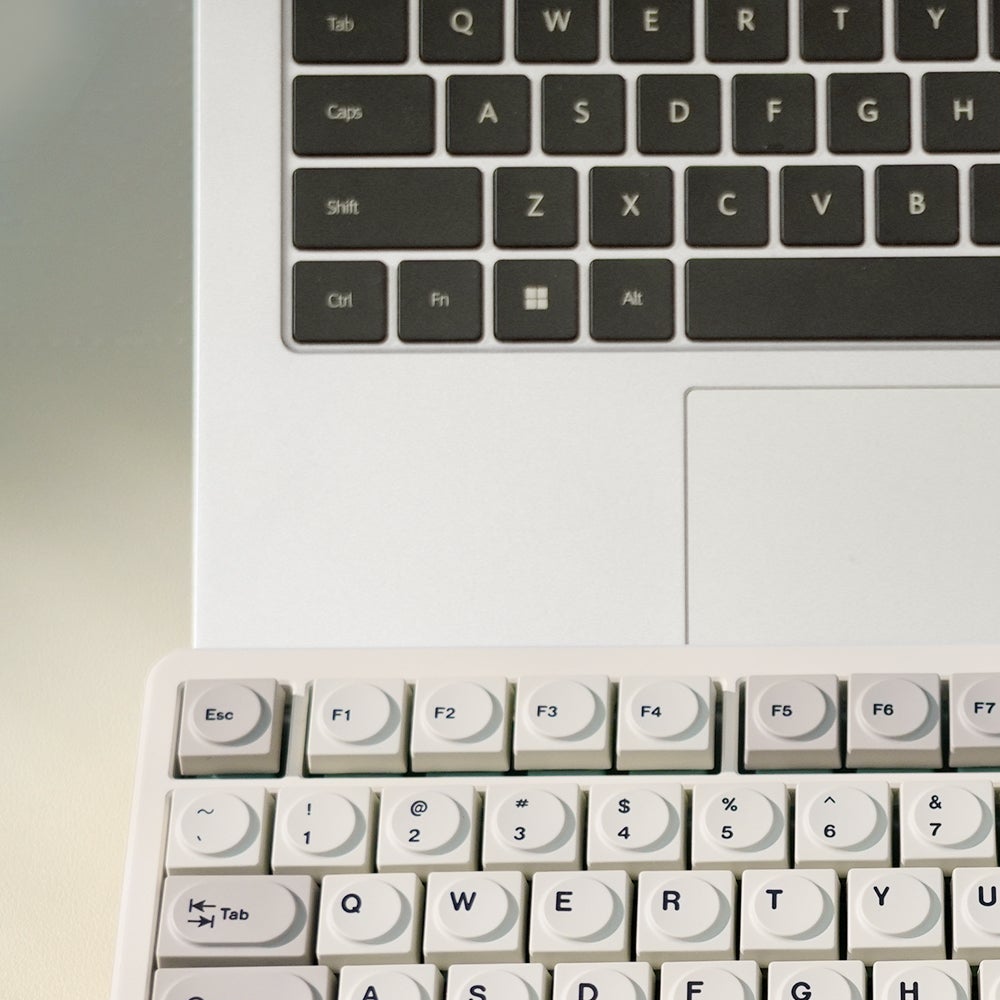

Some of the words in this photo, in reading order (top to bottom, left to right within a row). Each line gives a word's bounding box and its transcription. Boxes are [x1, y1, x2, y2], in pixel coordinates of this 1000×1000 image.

[327, 16, 354, 31] Tab
[451, 10, 472, 35] Q
[544, 10, 571, 31] W
[645, 10, 658, 31] E
[738, 9, 754, 30] R
[833, 8, 848, 30] T
[928, 9, 945, 29] Y
[327, 105, 362, 121] Caps
[479, 102, 497, 123] A
[575, 101, 589, 123] S
[670, 101, 689, 122] D
[768, 100, 781, 122] F
[858, 99, 878, 122] G
[954, 100, 973, 120] H
[328, 200, 359, 215] Shift
[528, 194, 544, 216] Z
[623, 195, 639, 216] X
[719, 193, 736, 215] C
[812, 194, 831, 215] V
[910, 192, 925, 214] B
[328, 293, 352, 307] Ctrl
[431, 292, 449, 306] Fn
[623, 291, 643, 305] Alt
[206, 709, 233, 720] Esc
[333, 709, 350, 720] F1
[435, 707, 455, 718] F2
[537, 706, 557, 717] F3
[641, 706, 661, 717] F4
[772, 705, 792, 716] F5
[874, 704, 893, 715] F6
[975, 702, 995, 713] F7
[308, 803, 311, 815] !
[411, 801, 427, 816] @
[516, 799, 528, 807] #
[619, 799, 630, 813] $
[722, 798, 737, 811] %
[929, 795, 941, 809] &
[409, 829, 420, 842] 2
[514, 827, 525, 840] 3
[618, 827, 630, 839] 4
[722, 826, 733, 839] 5
[824, 825, 835, 837] 6
[930, 823, 941, 836] 7
[304, 831, 310, 844] 1
[342, 894, 361, 913] Q
[450, 892, 476, 911] W
[556, 891, 572, 911] E
[663, 891, 680, 910] R
[766, 890, 783, 909] T
[874, 887, 889, 906] Y
[979, 886, 996, 906] U
[221, 908, 249, 920] Tab
